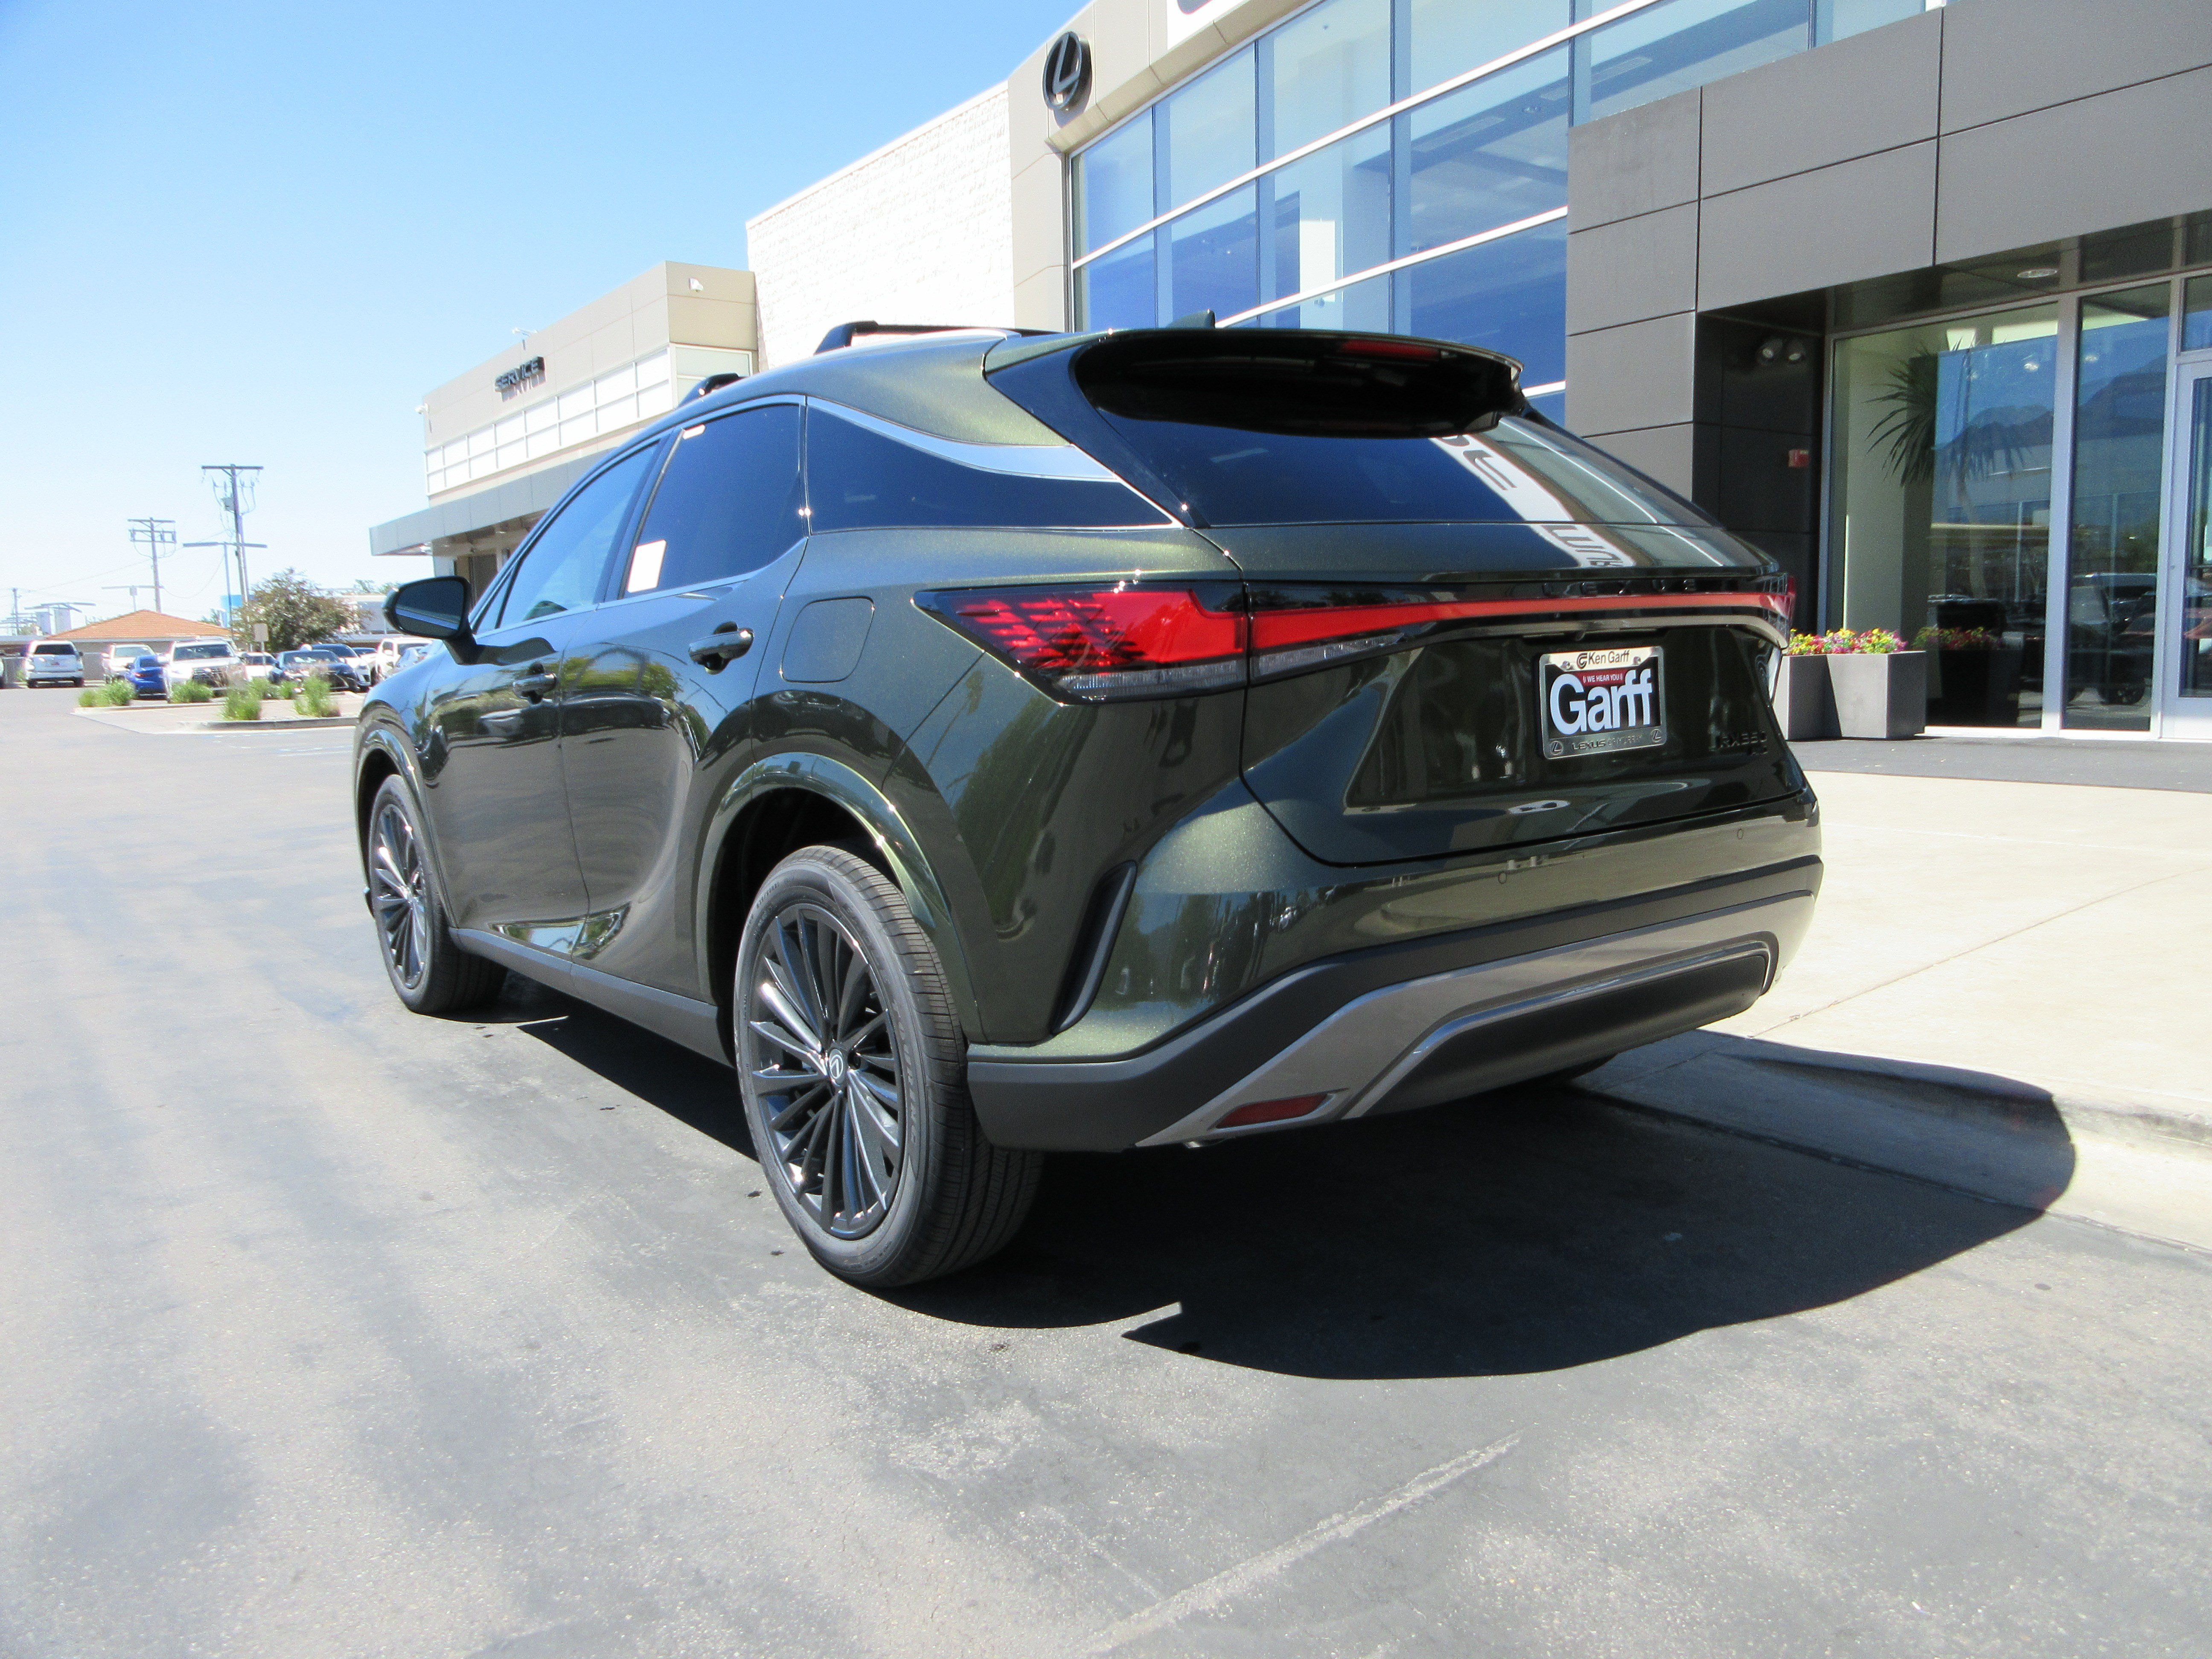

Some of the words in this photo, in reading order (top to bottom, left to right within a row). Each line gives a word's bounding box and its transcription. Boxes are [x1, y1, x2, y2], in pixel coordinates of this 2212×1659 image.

[1589, 652, 1606, 665] Ken
[1608, 649, 1630, 664] Garff
[1587, 675, 1595, 683] WE
[1596, 674, 1610, 682] HEAR
[1610, 673, 1619, 681] YOU
[1550, 669, 1653, 736] Garff
[1572, 739, 1606, 750] LEXUS
